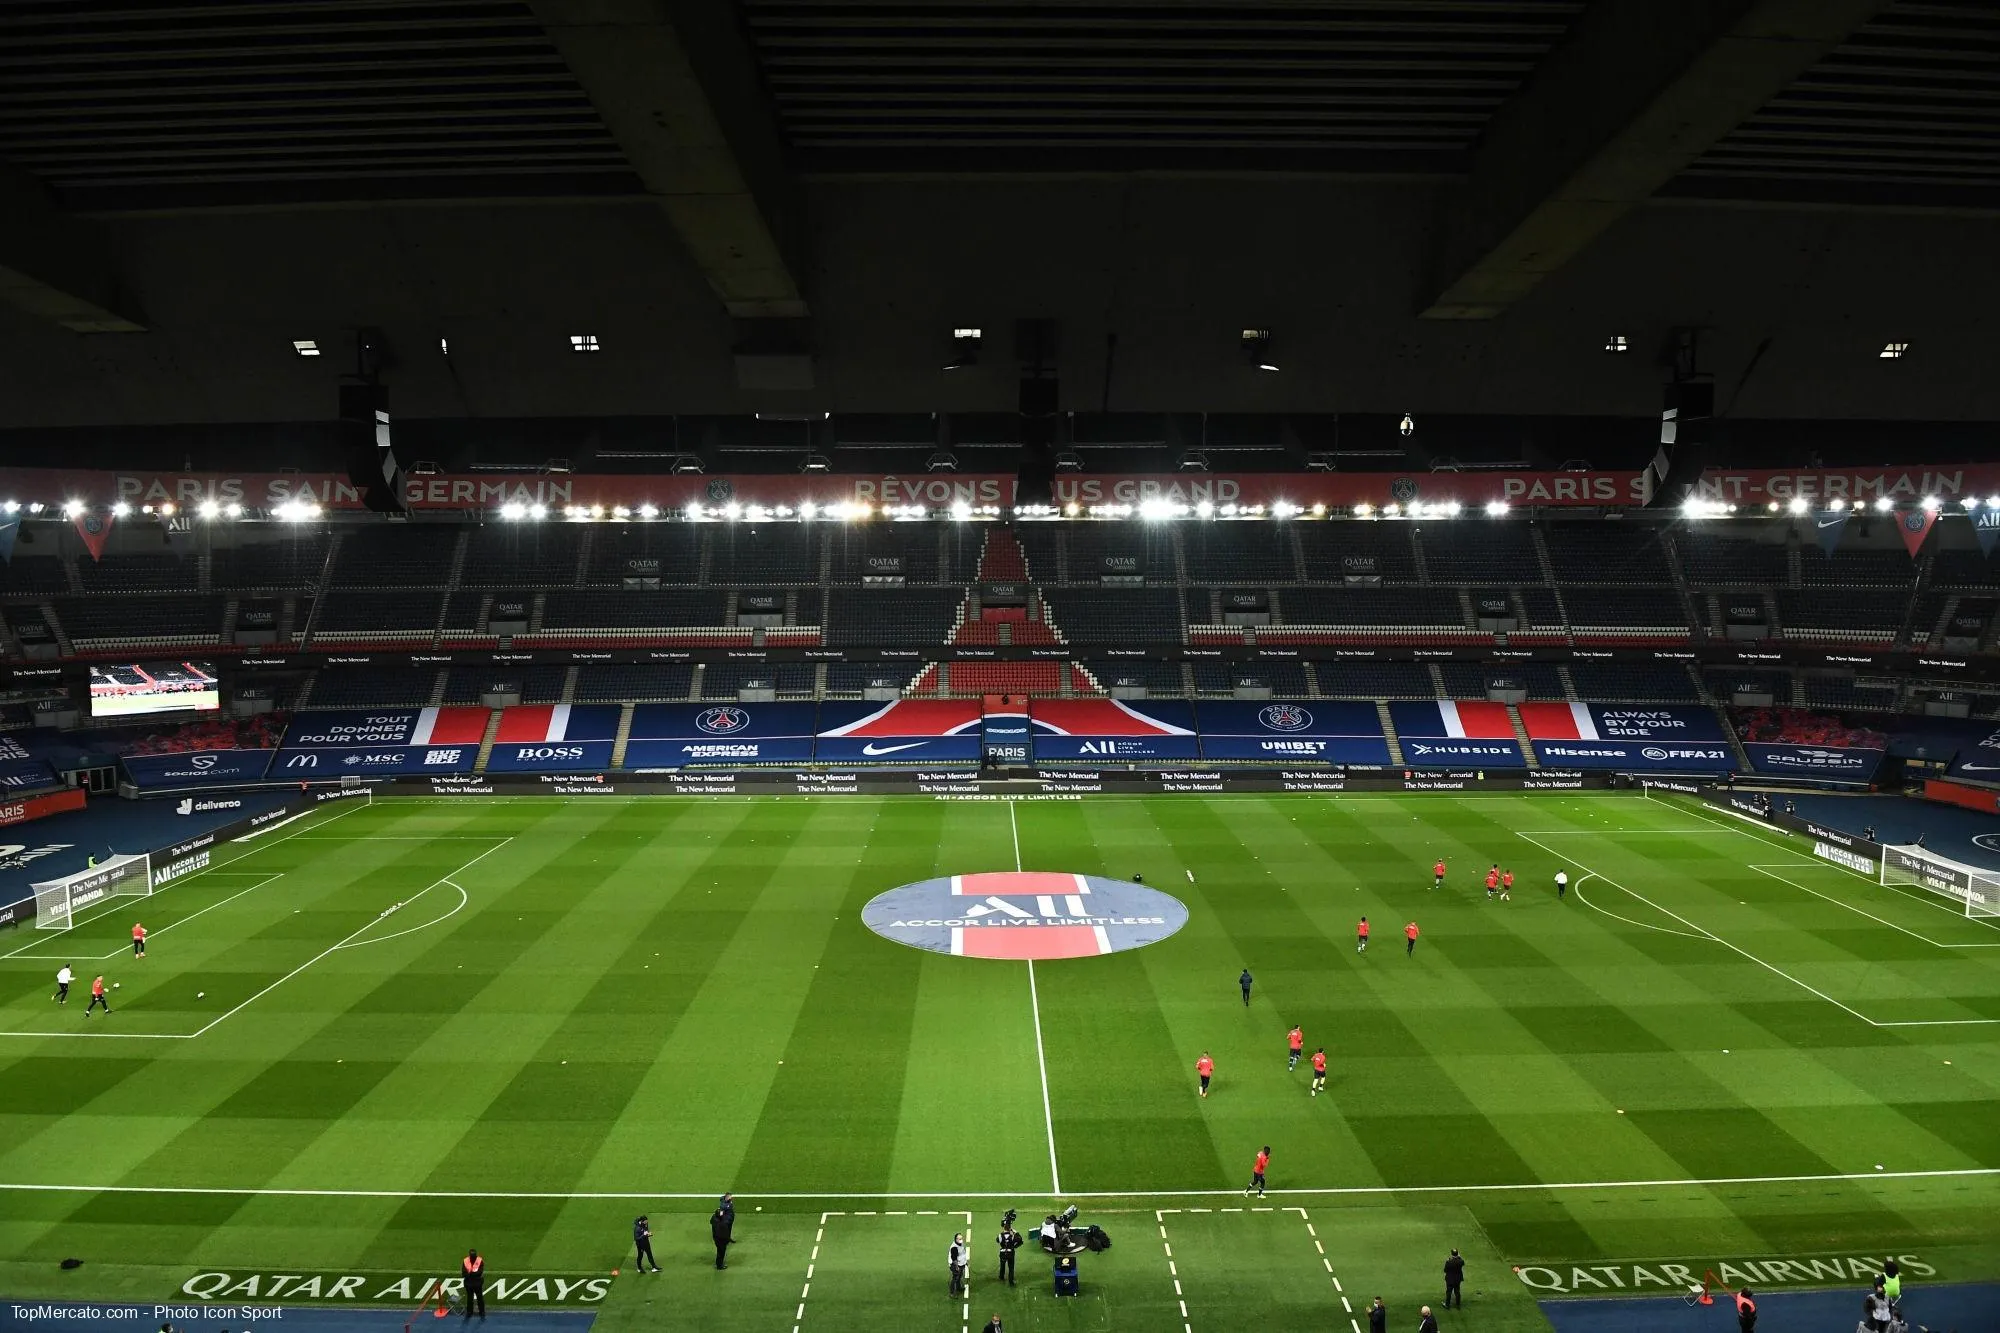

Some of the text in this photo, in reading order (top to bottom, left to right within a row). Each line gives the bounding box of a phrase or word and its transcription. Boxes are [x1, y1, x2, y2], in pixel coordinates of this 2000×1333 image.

[117, 476, 242, 502] PARIS
[855, 476, 1000, 502] RÊVONS
[1504, 478, 1616, 500] PARIS
[1106, 558, 1135, 566] QATAR
[1345, 558, 1374, 566] QATAR
[331, 725, 407, 733] DONNER
[517, 747, 583, 758] BOSS
[989, 748, 1025, 757] PARIS
[1079, 741, 1116, 753] All
[1545, 748, 1626, 756] Hisense
[364, 754, 405, 762] MSC
[1767, 754, 1862, 764] GAUSSIN
[164, 768, 240, 776] socios.com
[825, 774, 856, 782] Mercurial
[1670, 783, 1698, 792] Mercurial
[195, 800, 241, 810] deliveroo
[0, 804, 24, 818] ARIS
[1808, 824, 1852, 846] The New Mercurial
[172, 848, 181, 856] The
[172, 851, 210, 870] ACCOR LIVE
[172, 858, 210, 878] LIMITLESS
[154, 866, 172, 885] All
[1927, 876, 1947, 889] VISIT
[72, 888, 104, 907] RWANDA
[960, 896, 1092, 919] All
[890, 920, 980, 928] ACCOR
[1048, 917, 1165, 926] LIMITLESS
[1518, 1264, 1704, 1292] QATAR
[182, 1272, 366, 1299] QATAR
